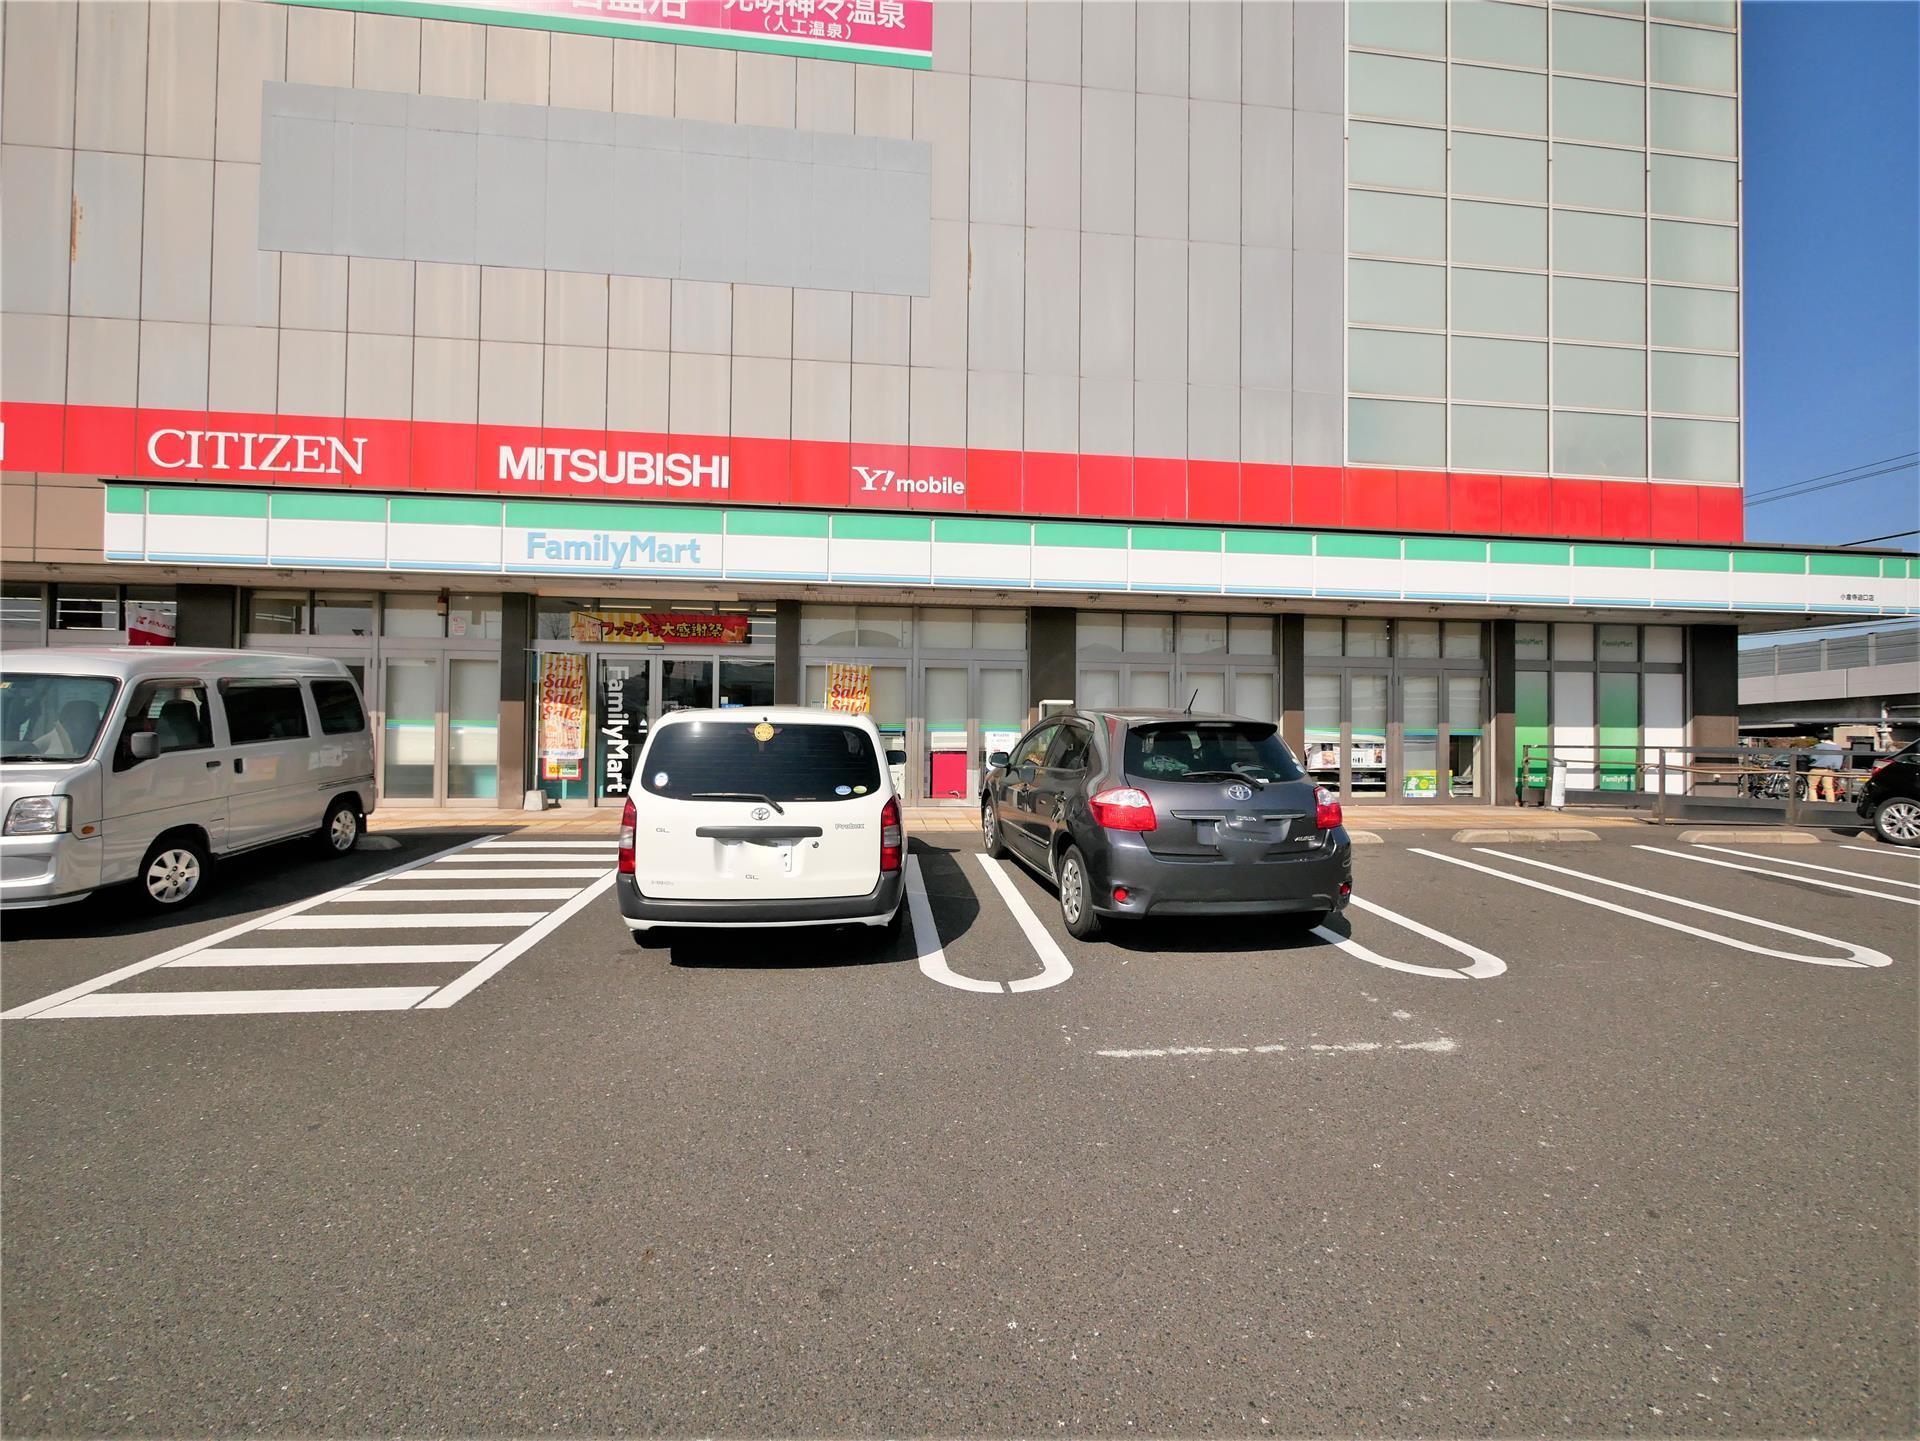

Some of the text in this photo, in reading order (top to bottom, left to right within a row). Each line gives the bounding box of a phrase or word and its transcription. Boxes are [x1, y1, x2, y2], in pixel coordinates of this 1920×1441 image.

[147, 428, 368, 475] CITIZEN
[498, 445, 730, 488] MITSUBISHI
[527, 532, 702, 569] FamilyMart
[544, 674, 583, 689] Sale!
[831, 683, 868, 701] Sale!
[543, 689, 583, 705] Sale!
[542, 705, 583, 721] Sale!
[601, 666, 629, 793] FamilyMart
